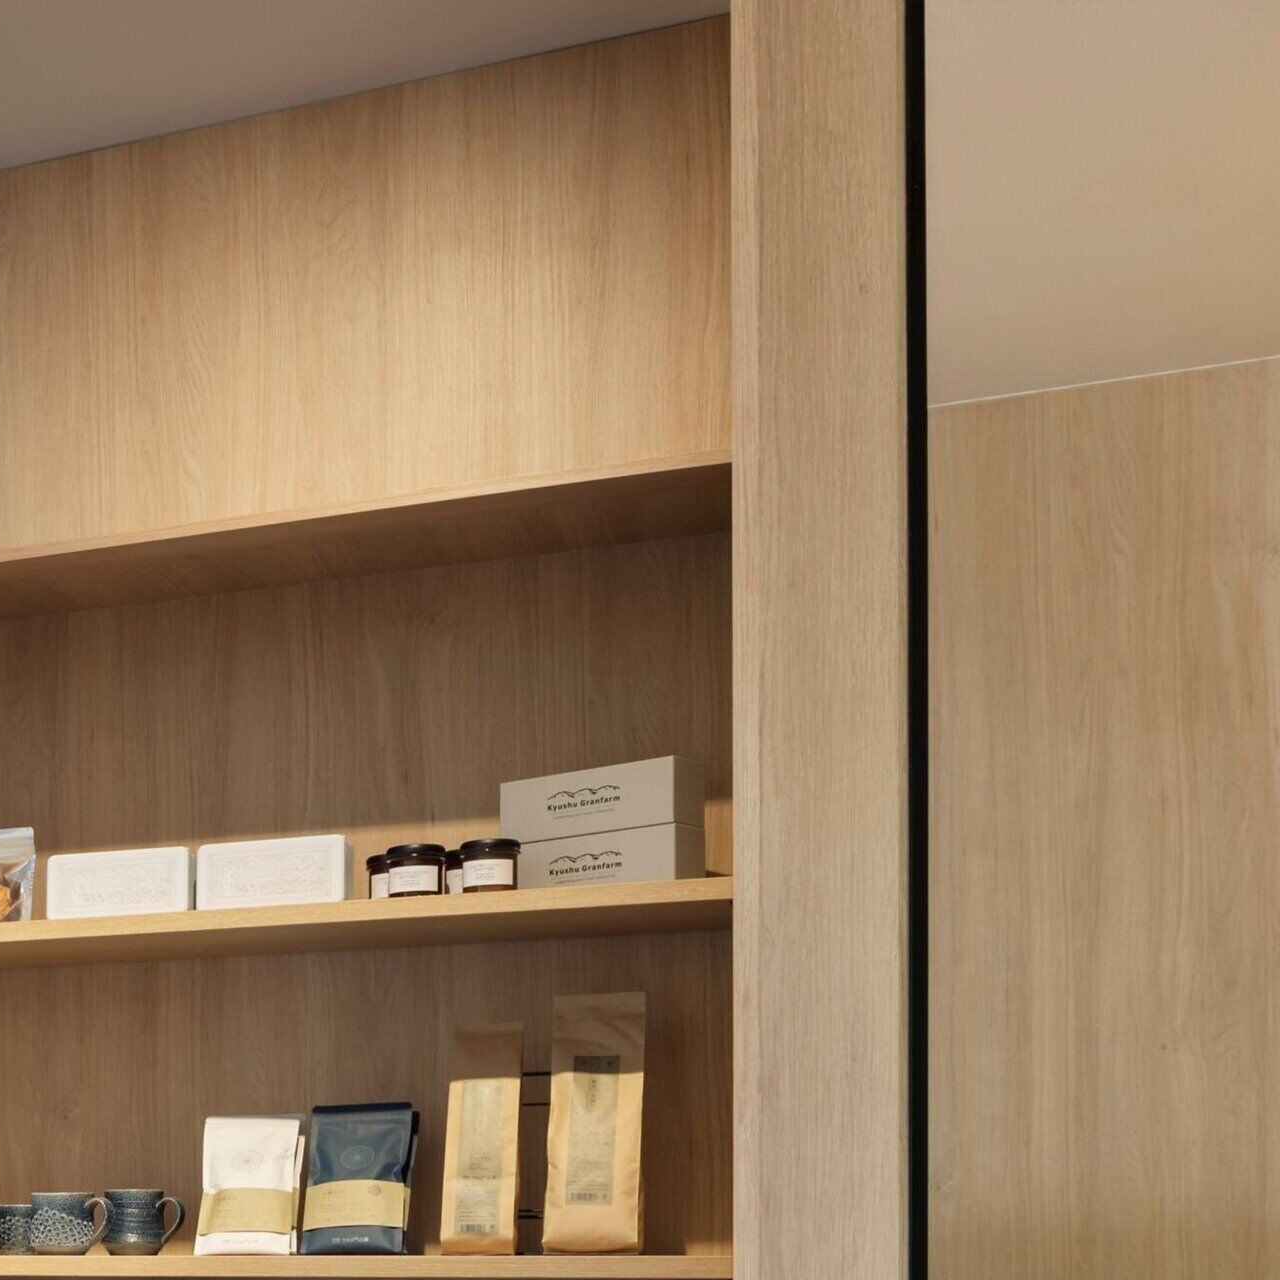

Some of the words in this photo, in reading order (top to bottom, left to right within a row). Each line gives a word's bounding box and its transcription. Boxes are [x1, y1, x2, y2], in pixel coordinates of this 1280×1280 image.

[547, 801, 578, 812] Kyushu
[580, 795, 620, 807] Granfarm
[549, 866, 579, 876] Kyushu
[582, 861, 622, 872] Granfarm
